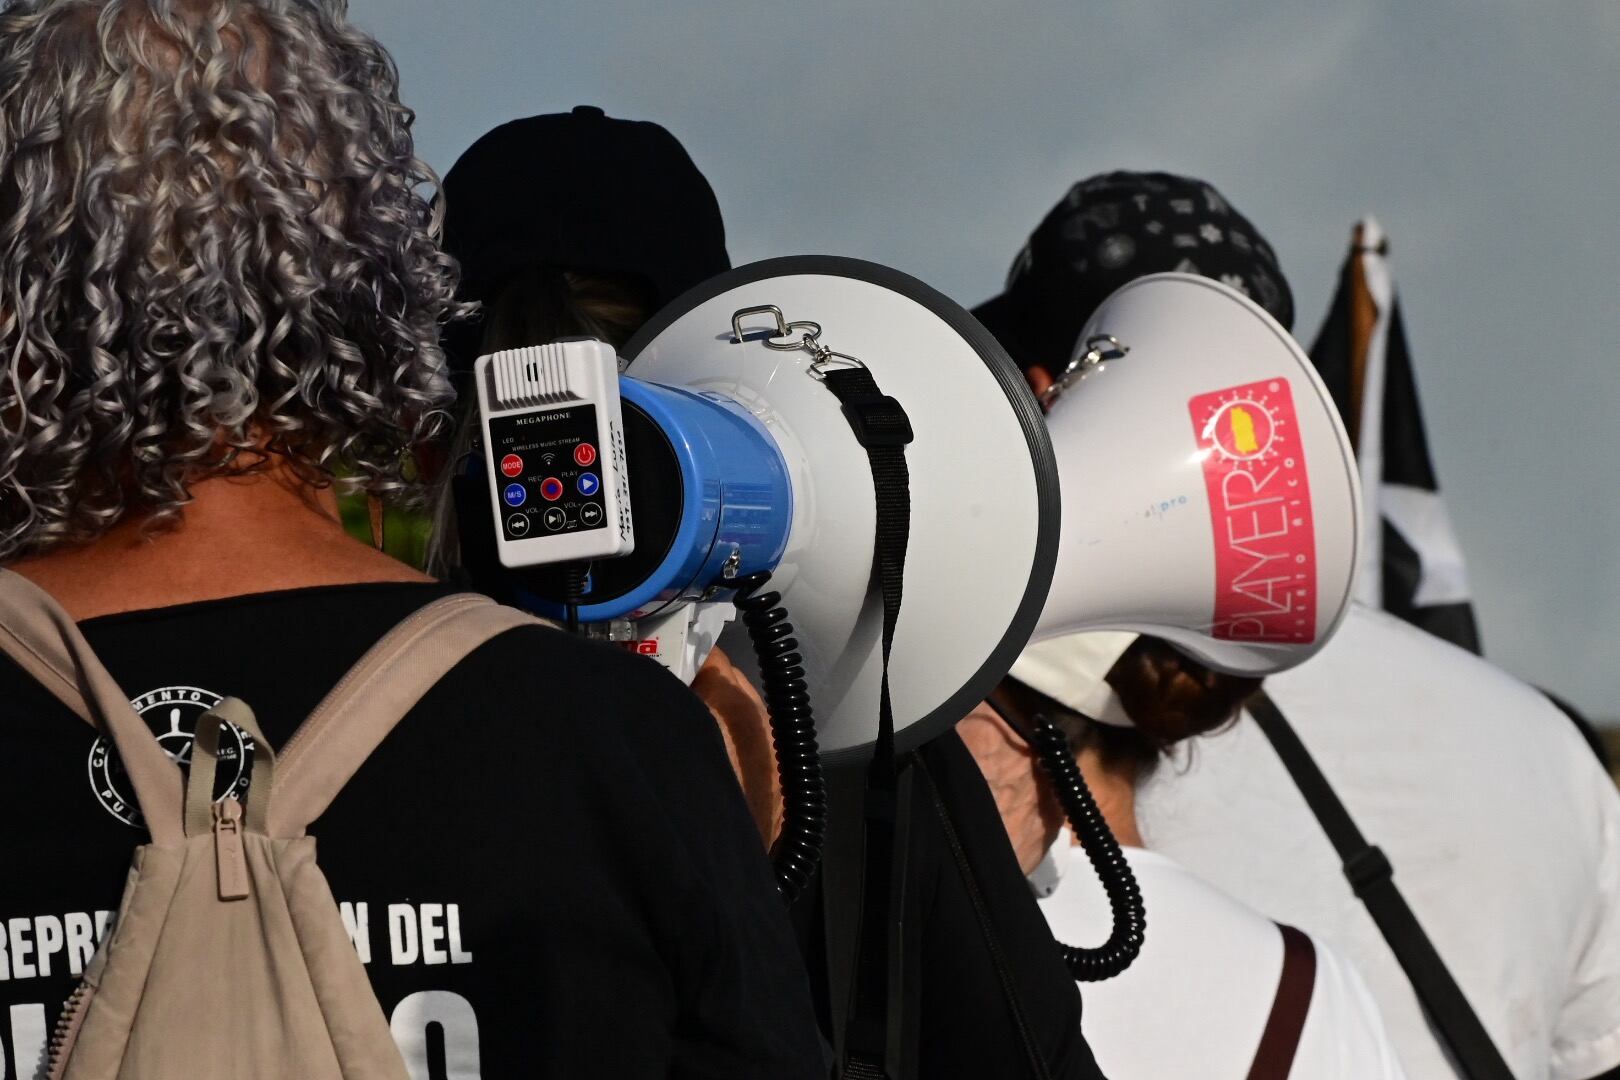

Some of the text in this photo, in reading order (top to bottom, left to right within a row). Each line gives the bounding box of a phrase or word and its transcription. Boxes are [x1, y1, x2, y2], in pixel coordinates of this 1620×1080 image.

[516, 412, 571, 426] MEGAPHONE
[512, 442, 540, 452] WIRELESS
[558, 437, 581, 446] STREAM
[502, 461, 521, 470] MODE
[528, 475, 543, 483] REC
[507, 491, 522, 499] M/S
[388, 902, 473, 966] DEL
